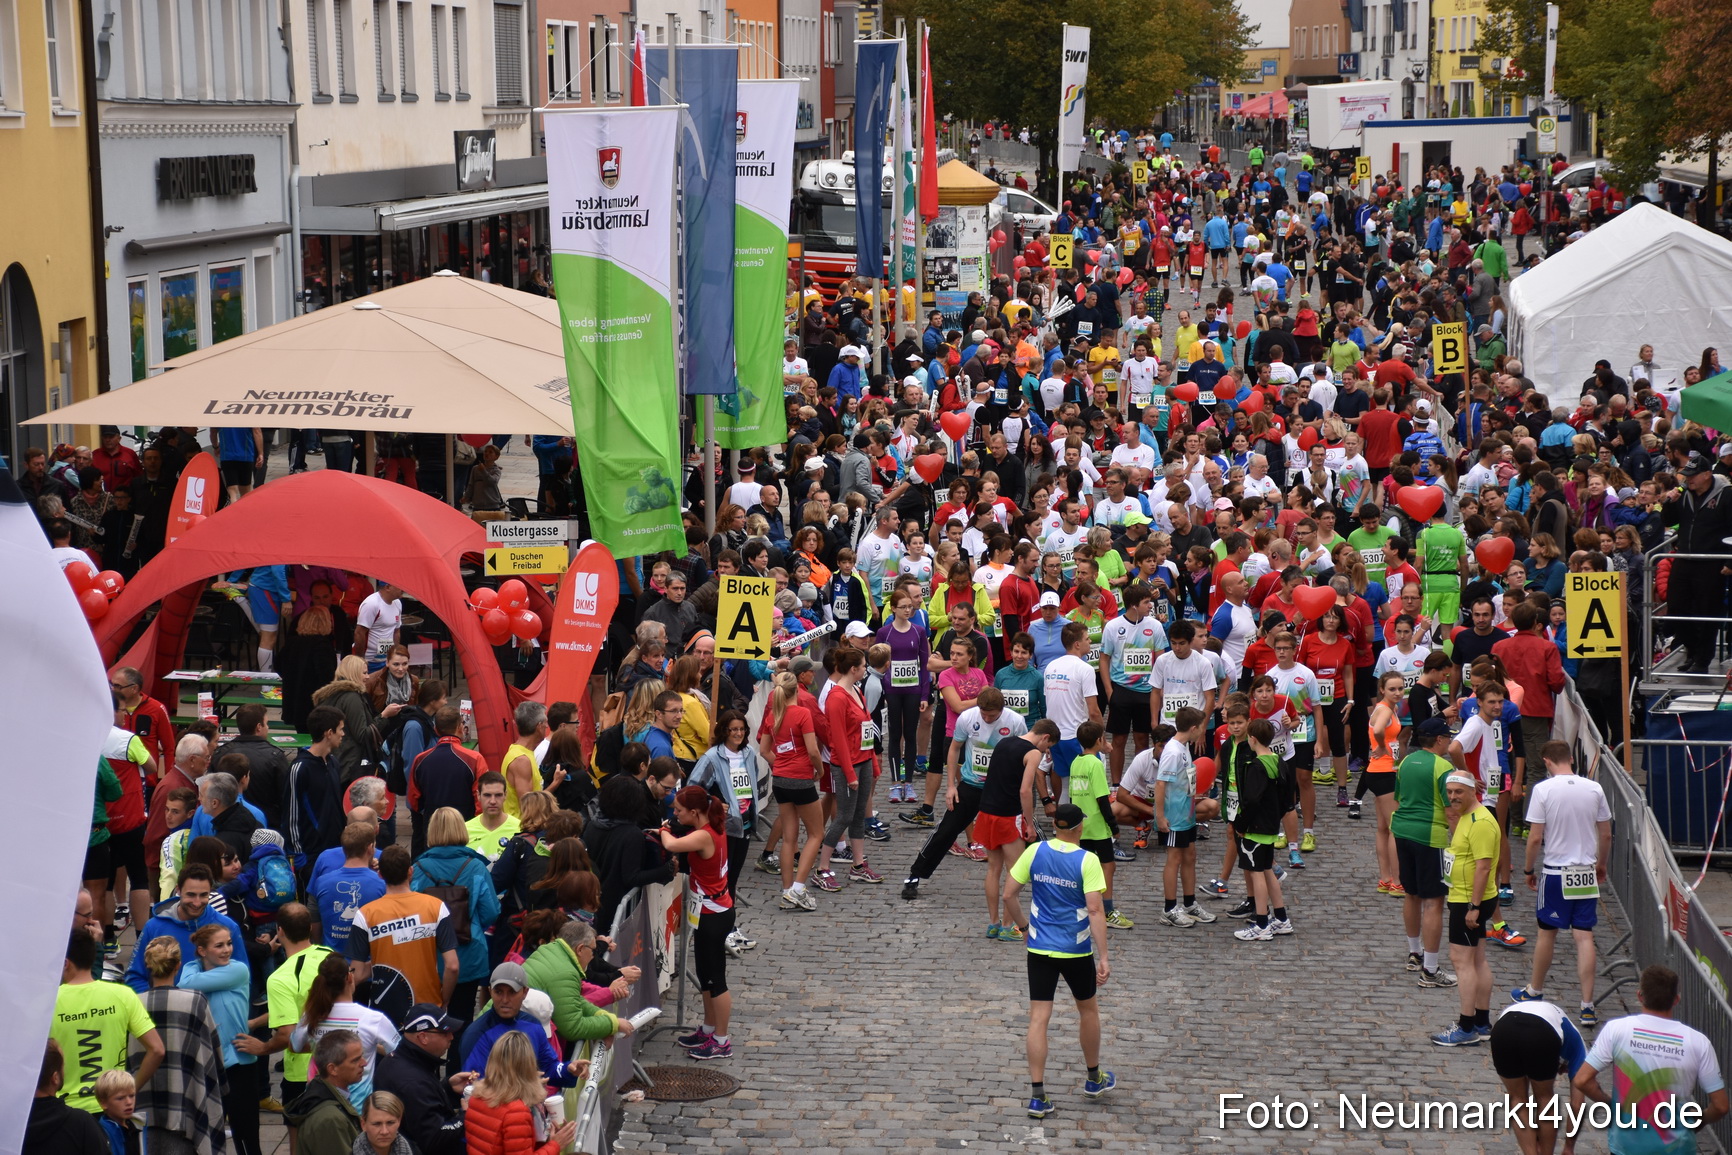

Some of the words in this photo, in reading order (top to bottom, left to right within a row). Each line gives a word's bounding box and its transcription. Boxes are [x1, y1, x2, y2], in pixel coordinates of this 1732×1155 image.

[1136, 168, 1146, 179] D
[1359, 164, 1368, 175] D
[168, 156, 215, 201] BRILLEN
[216, 154, 258, 196] WEBER
[1052, 235, 1071, 243] Block
[1055, 244, 1068, 261] C
[1436, 325, 1464, 336] Block
[1441, 338, 1460, 364] B
[243, 389, 395, 404] Neumarkter
[203, 399, 414, 420] Lammsbräu
[186, 500, 201, 511] DKMS
[491, 525, 559, 539] Klostergasse
[510, 552, 544, 561] Duschen
[1363, 553, 1385, 564] 5307
[512, 561, 542, 570] Freibad
[726, 578, 770, 597] Block
[1572, 575, 1620, 592] Block
[575, 598, 595, 611] DKMS
[727, 601, 760, 643] A
[1579, 597, 1615, 640] A
[555, 641, 593, 653] www.dkms.de
[1126, 655, 1150, 665] 5082
[894, 666, 917, 677] 5068
[1165, 701, 1189, 711] 5192
[1072, 780, 1089, 791] DAV
[1033, 872, 1078, 889] NÜRNBERG
[1565, 873, 1595, 887] 5308
[370, 917, 417, 937] Benzin
[410, 926, 436, 941] Blut
[58, 1011, 88, 1023] Team
[90, 1005, 116, 1018] Partl
[1629, 1039, 1685, 1057] NeuerMarkt
[77, 1029, 103, 1098] BMW
